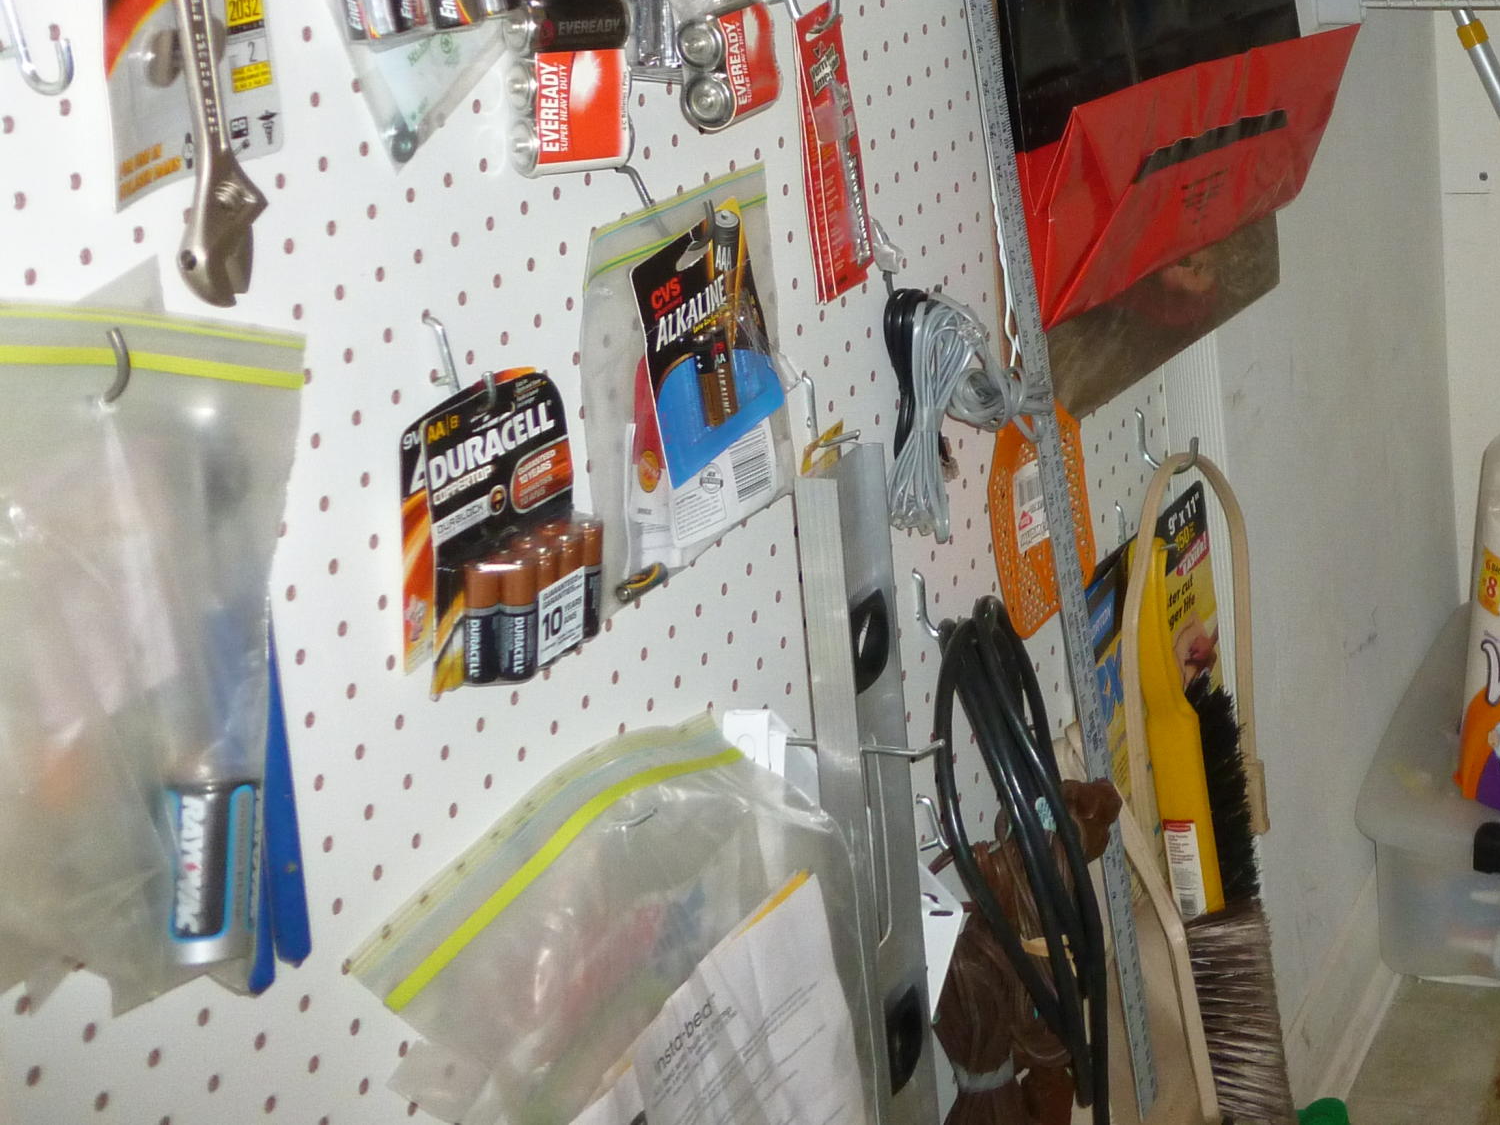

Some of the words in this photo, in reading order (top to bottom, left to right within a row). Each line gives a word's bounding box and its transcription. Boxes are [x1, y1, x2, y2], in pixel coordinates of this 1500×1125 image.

[557, 18, 621, 36] EVEREADY
[246, 41, 258, 63] 2
[722, 21, 748, 107] EVEREADY
[560, 64, 568, 92] DUTY
[539, 61, 560, 153] EVEREADY
[560, 92, 569, 124] HEAVY
[559, 125, 569, 152] SUPER
[715, 245, 733, 271] AAA
[651, 276, 682, 311] CVS
[656, 273, 729, 353] ALKALINE
[427, 421, 447, 444] AA
[429, 401, 555, 491] DURACELL
[433, 463, 495, 506] COPPERTOP
[527, 460, 554, 481] YEARS
[1181, 573, 1194, 595] cut
[542, 604, 564, 642] 10
[563, 595, 583, 613] YEARS
[1183, 593, 1197, 615] life
[468, 618, 482, 678] DURACELL
[512, 616, 526, 676] DURACELL
